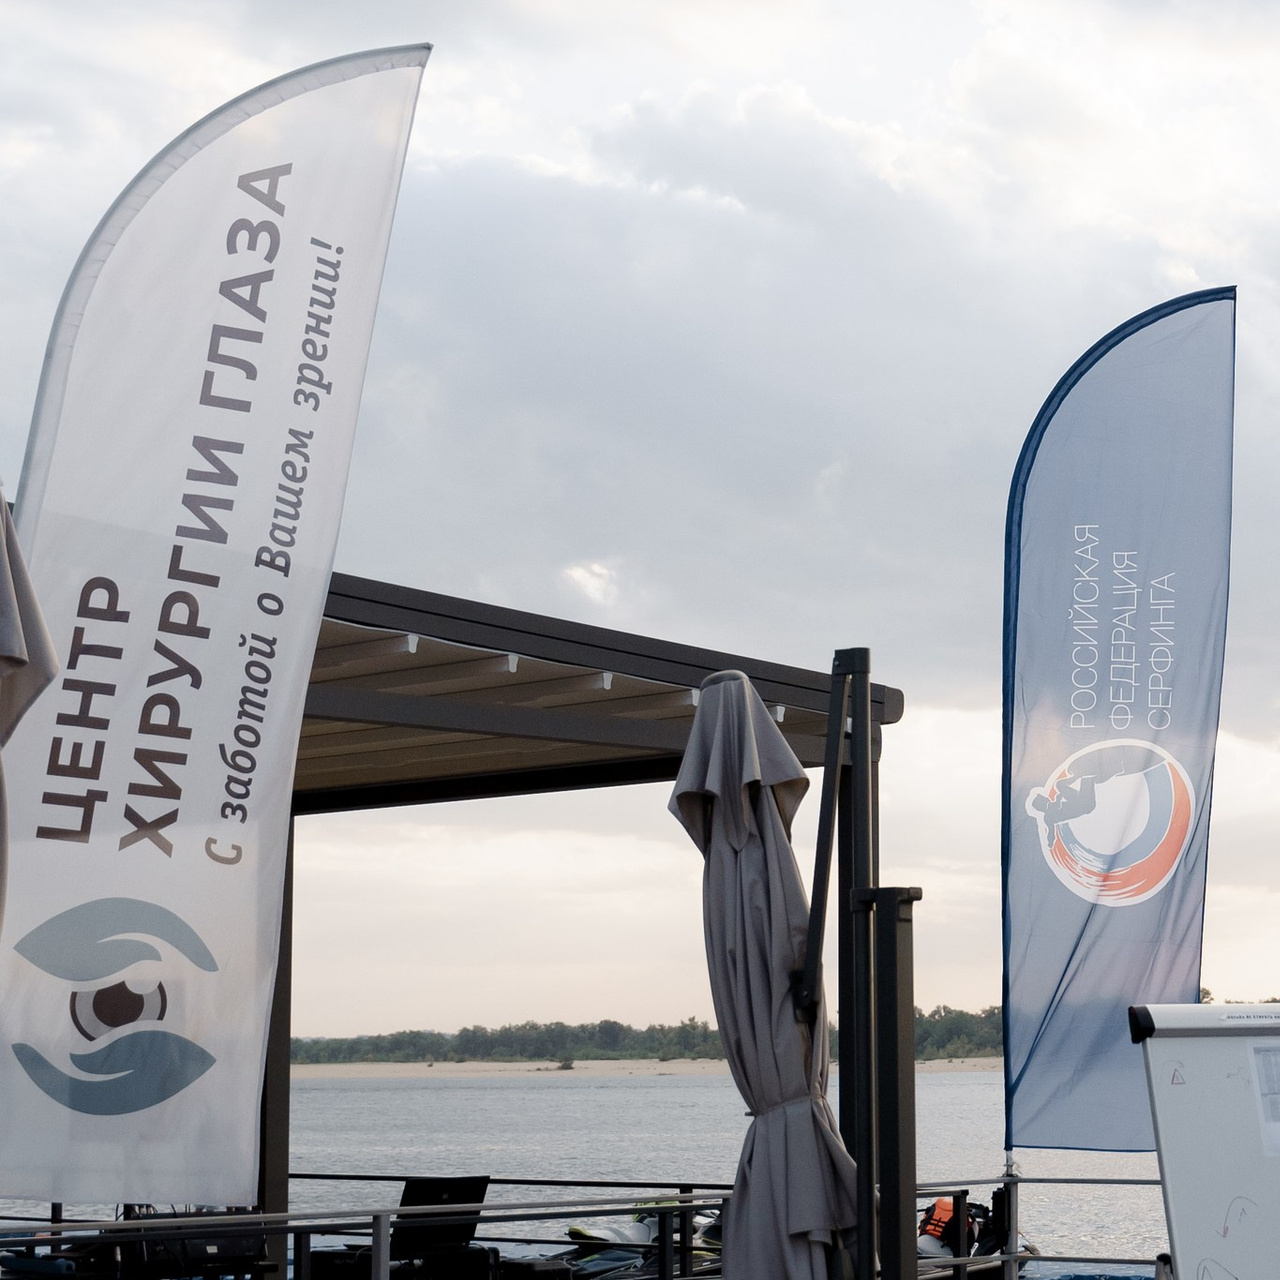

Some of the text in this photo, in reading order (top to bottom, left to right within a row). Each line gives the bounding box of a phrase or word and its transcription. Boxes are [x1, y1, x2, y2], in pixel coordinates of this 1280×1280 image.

[118, 162, 293, 859] ХИРУРГИИ ГЛАЗА
[204, 236, 345, 866] С заботой о Вашем зрении!
[1067, 524, 1100, 729] РОССИЙСКАЯ
[35, 576, 131, 844] ЦЕНТР
[1108, 551, 1143, 730] ФЕДЕРАЦИЯ
[1147, 572, 1176, 730] СЕРФИНГА
